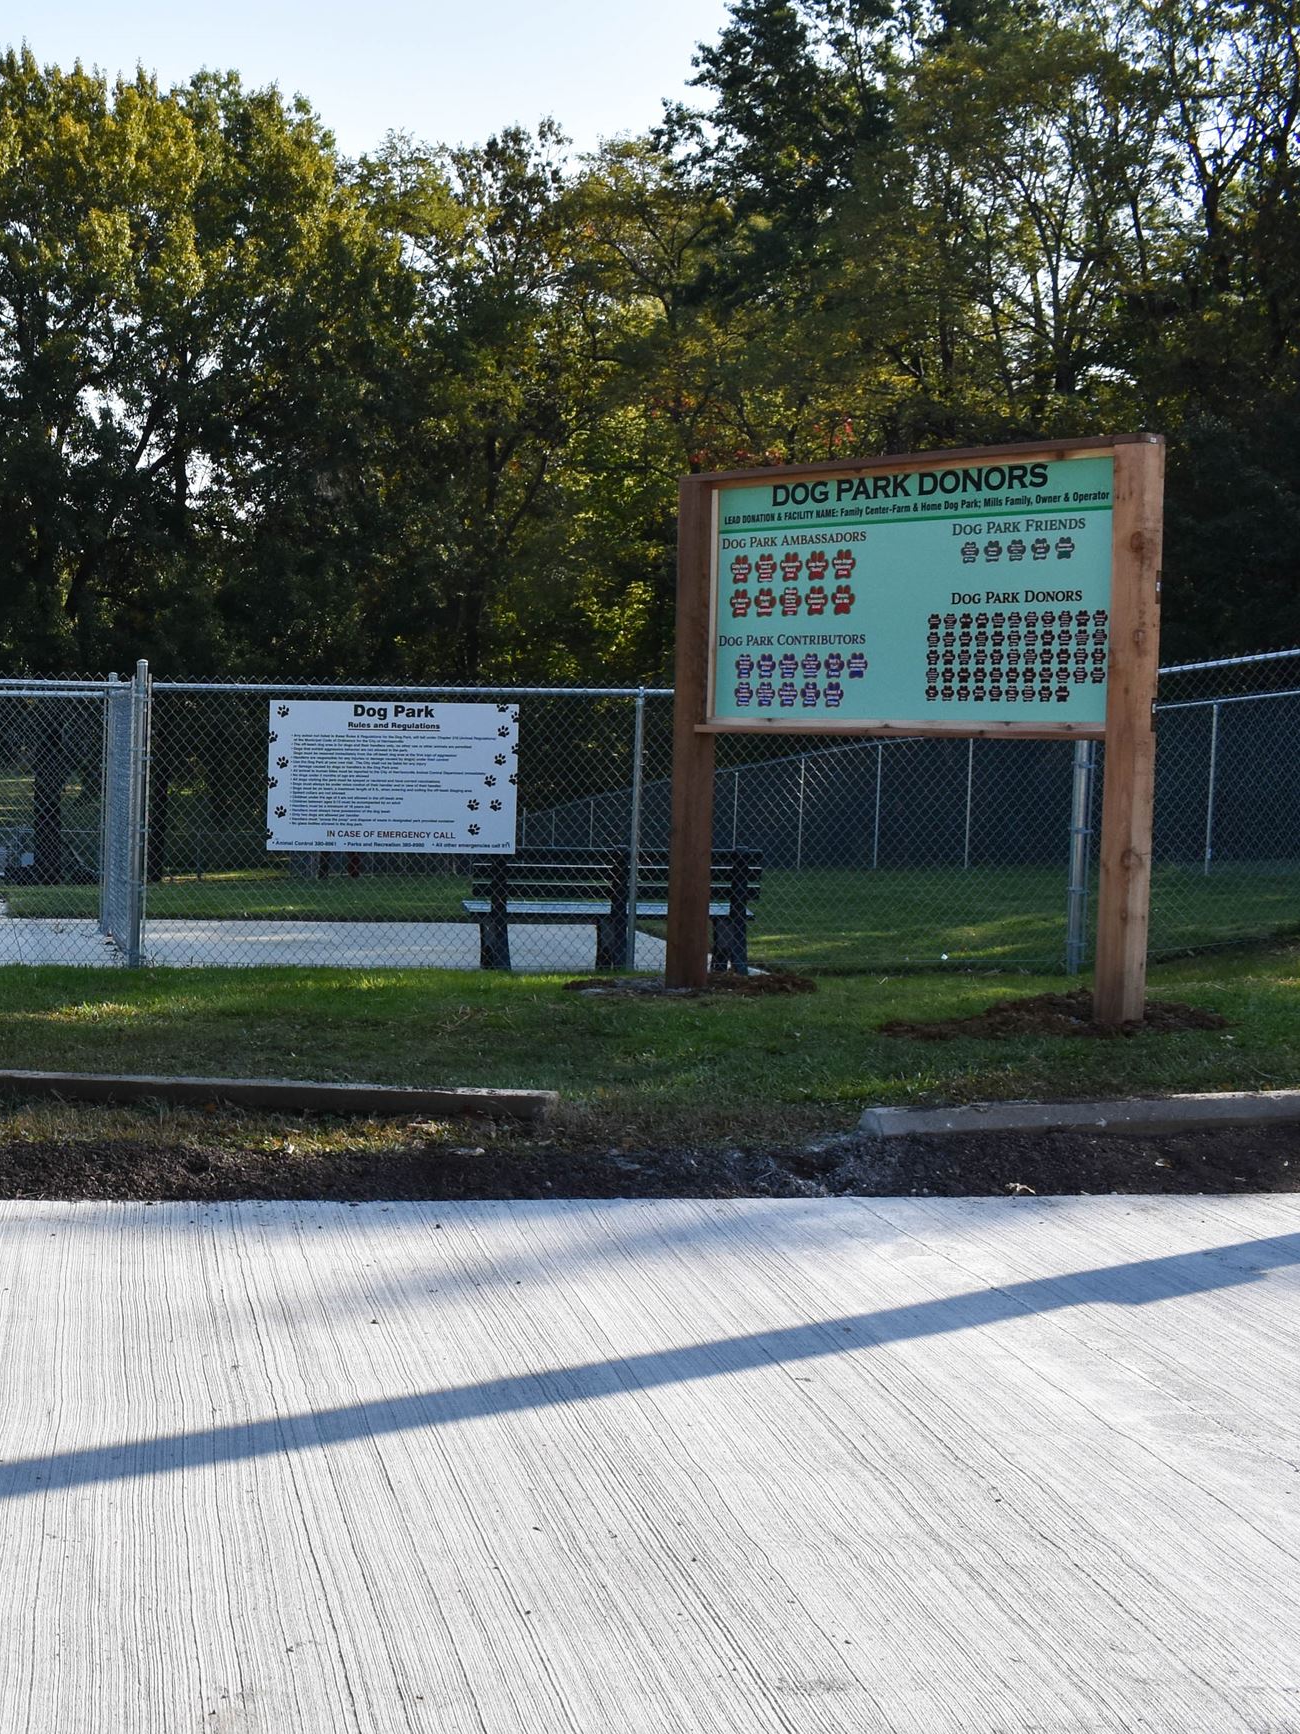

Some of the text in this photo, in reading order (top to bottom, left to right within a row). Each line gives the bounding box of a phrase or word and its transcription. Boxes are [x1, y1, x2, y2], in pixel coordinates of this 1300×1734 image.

[772, 464, 1048, 507] DOG PARK DONORS
[725, 515, 740, 525] LEAD
[742, 513, 775, 524] DONATION
[785, 510, 813, 520] FACILITY
[816, 509, 838, 519] NAME:
[841, 506, 863, 517] Family
[866, 504, 910, 515] Center-Farm
[913, 504, 918, 512] &
[921, 502, 942, 511] Home
[944, 500, 958, 512] Dog
[961, 498, 981, 509] Park;
[984, 497, 1003, 507] Mills
[1005, 495, 1033, 507] Family,
[1036, 494, 1060, 504] Owner
[1064, 492, 1069, 501] &
[1073, 490, 1109, 502] Operator
[354, 704, 434, 720] Dog Park
